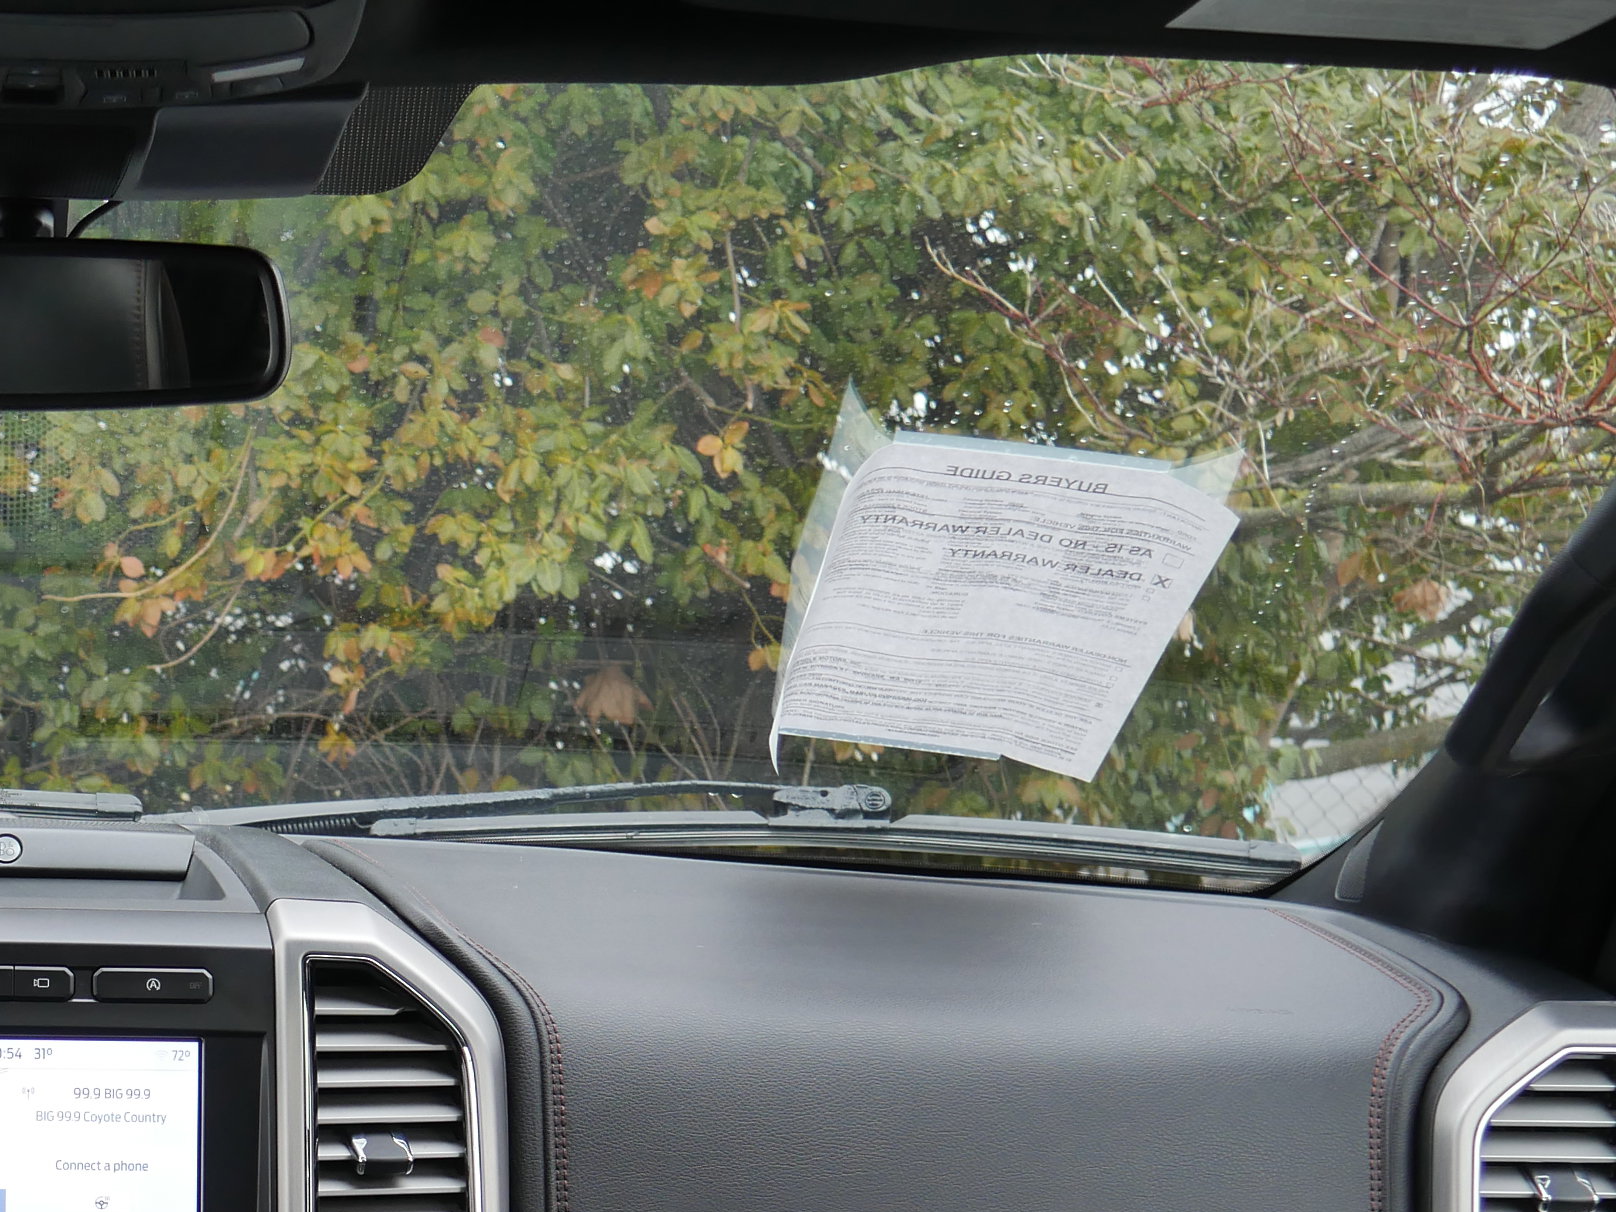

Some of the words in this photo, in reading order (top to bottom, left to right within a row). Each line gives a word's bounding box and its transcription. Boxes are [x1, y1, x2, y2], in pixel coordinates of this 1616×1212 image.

[73, 1088, 101, 1100] 99.9
[104, 1089, 123, 1100] BIG
[126, 1089, 151, 1100] 99.9
[36, 1111, 55, 1122] BIG
[57, 1111, 81, 1122] 99.9
[83, 1112, 122, 1125] Coyote
[124, 1112, 167, 1125] Country
[55, 1160, 101, 1171] Connect
[104, 1163, 111, 1172] a
[113, 1161, 149, 1173] phone
